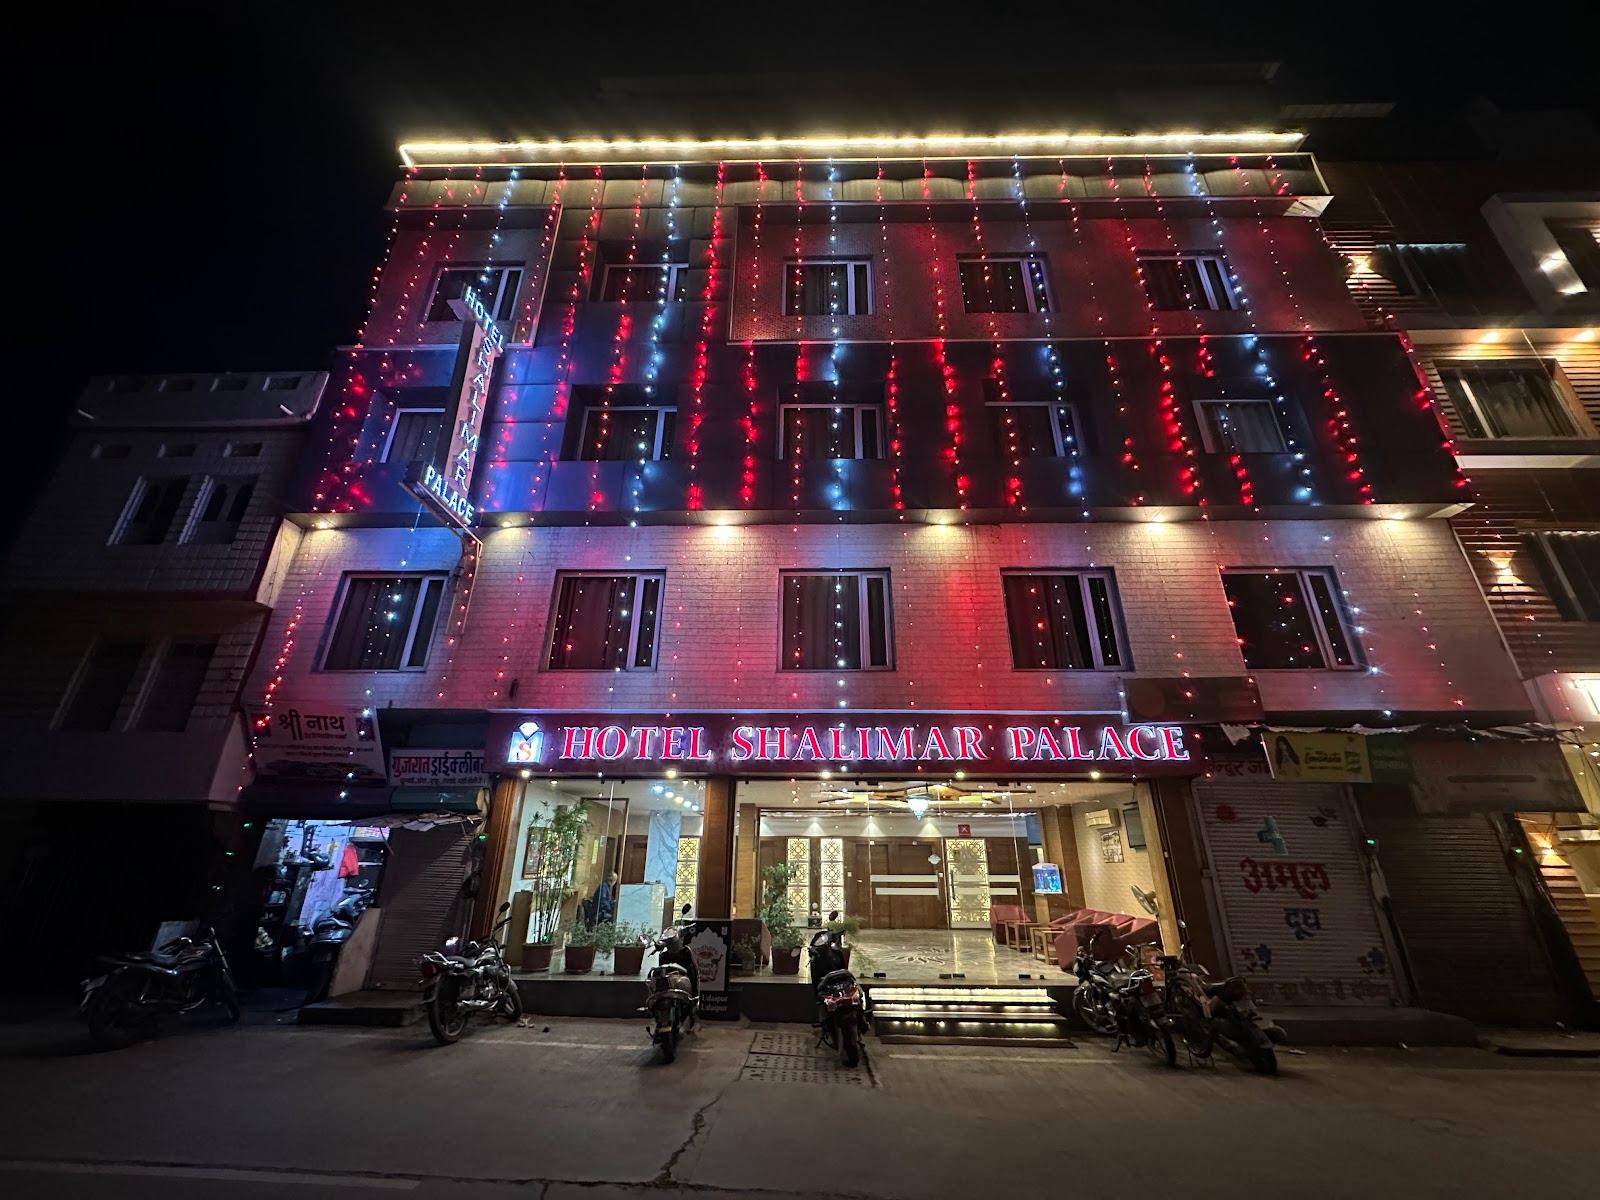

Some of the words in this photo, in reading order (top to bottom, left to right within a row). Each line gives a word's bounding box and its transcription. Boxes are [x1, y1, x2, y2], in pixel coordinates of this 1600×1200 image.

[465, 286, 504, 353] HOTEL
[454, 335, 493, 492] SHALIMAR
[424, 465, 475, 525] PALACE
[278, 709, 303, 740] श्री
[304, 714, 345, 732] नाथ
[560, 726, 712, 761] HOTEL
[731, 726, 990, 762] SHALIMAR
[1008, 725, 1190, 762] PALACE
[391, 756, 430, 777] गुजरात
